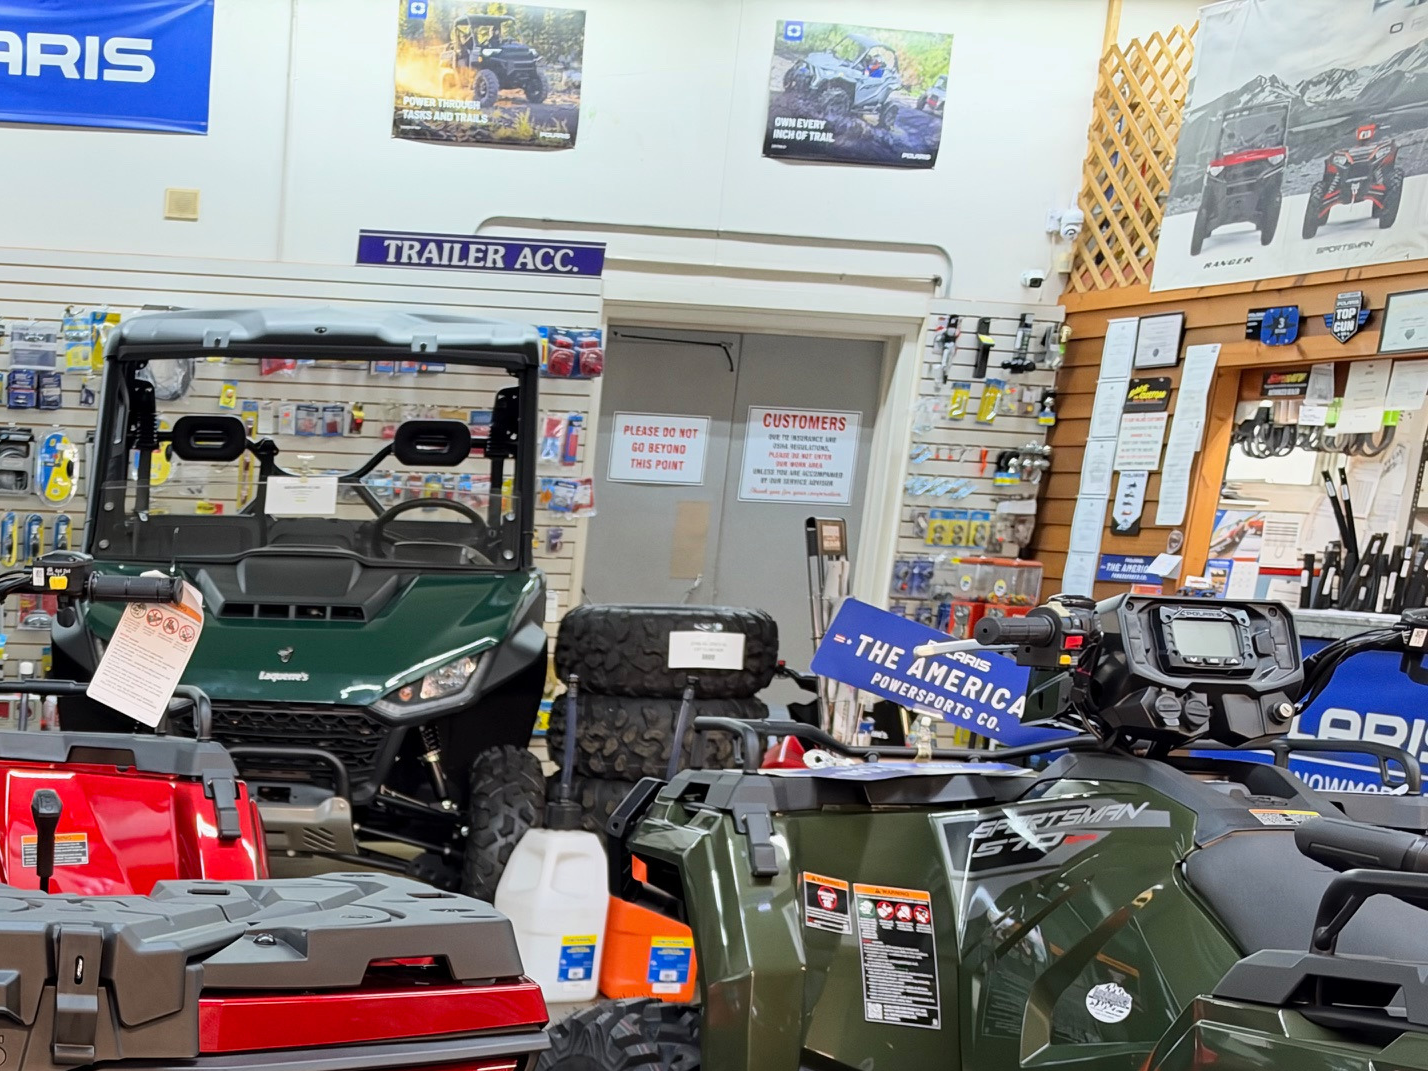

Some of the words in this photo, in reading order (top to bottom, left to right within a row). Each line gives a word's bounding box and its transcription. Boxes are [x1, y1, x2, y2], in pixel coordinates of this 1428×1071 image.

[403, 96, 436, 109] POWER
[438, 98, 480, 111] THROUGH
[402, 110, 432, 121] TASKS
[434, 111, 454, 122] AND
[454, 112, 488, 124] TRAILS
[774, 117, 796, 128] OWN
[796, 118, 826, 130] EVERY
[773, 128, 795, 140] INCH
[796, 130, 808, 140] OF
[809, 131, 836, 143] TRAIL
[1316, 240, 1374, 254] SPORTSMAN
[384, 239, 506, 268] TRAILER
[514, 246, 579, 273] ACC.
[1203, 256, 1254, 269] RANGER
[1336, 308, 1356, 320] TOP
[1278, 318, 1286, 328] 3
[1334, 320, 1355, 332] GUN
[763, 413, 846, 431] CUSTOMERS
[624, 425, 660, 437] PLEASE
[662, 427, 676, 438] DO
[679, 428, 698, 438] NOT
[632, 442, 645, 452] GO
[648, 443, 686, 454] BEYOND
[631, 458, 652, 470] THIS
[655, 460, 684, 470] POINT
[1106, 563, 1121, 572] THE
[1122, 564, 1149, 574] AMERIC
[855, 634, 905, 670] THE
[258, 670, 310, 682] Laquerre's
[870, 672, 974, 720] POWERSPORTS
[976, 712, 1000, 732] CO.
[972, 832, 1066, 858] 570
[882, 888, 910, 897] WARNING
